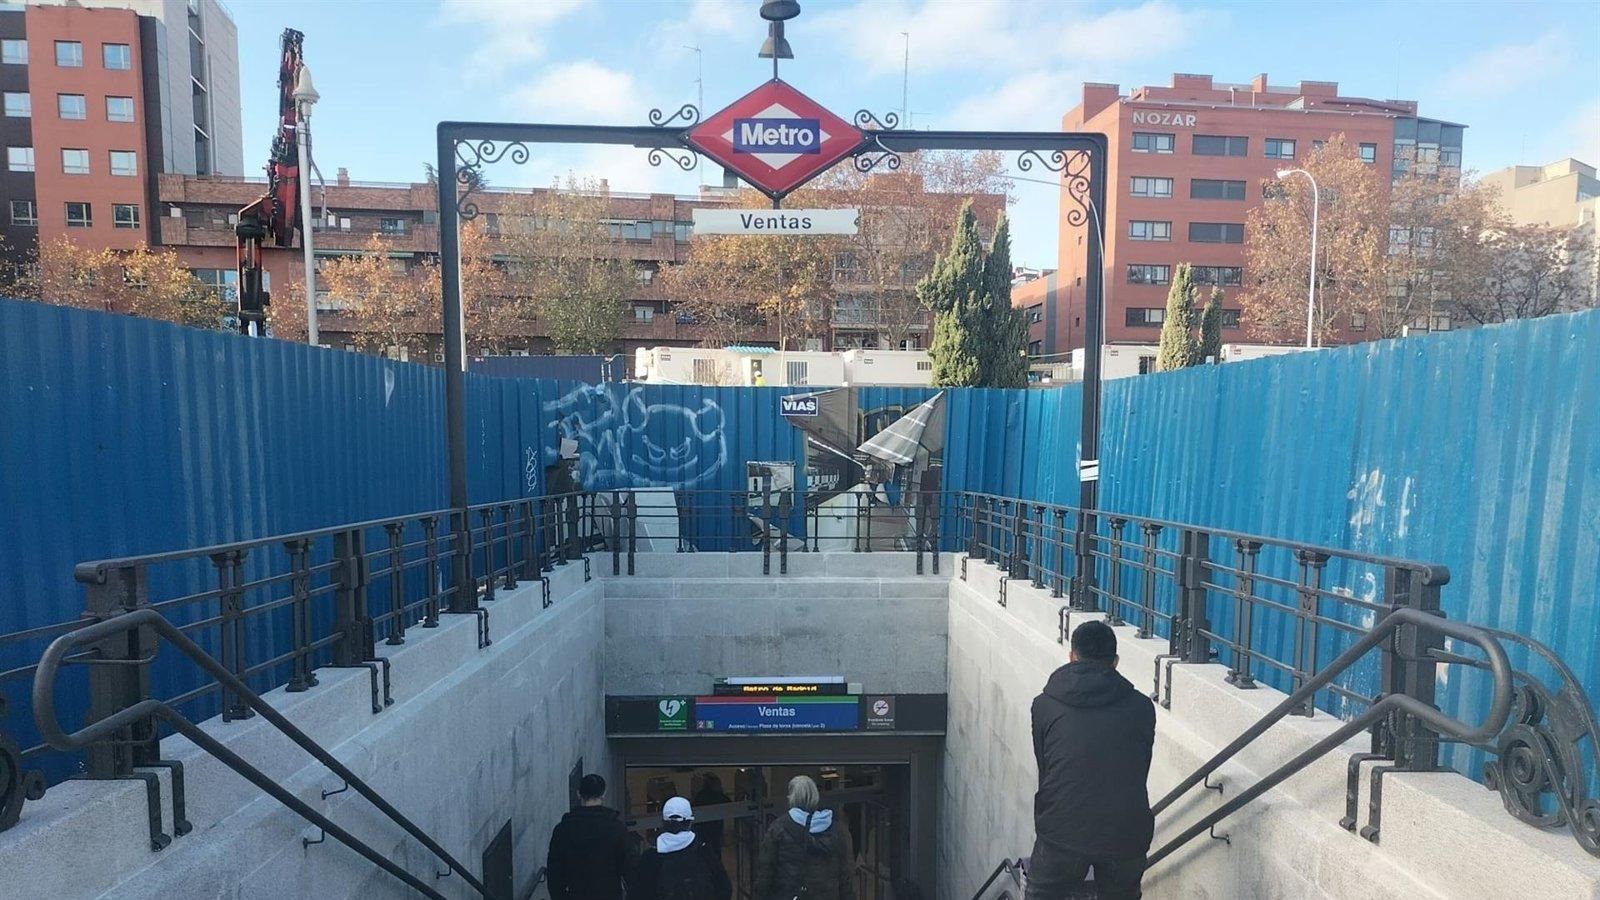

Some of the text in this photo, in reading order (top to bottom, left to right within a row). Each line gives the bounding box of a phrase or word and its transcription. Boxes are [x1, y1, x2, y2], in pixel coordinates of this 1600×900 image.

[1133, 111, 1196, 127] NOZAR
[741, 123, 814, 146] Metro
[740, 213, 812, 229] Ventas
[783, 401, 816, 411] VIAS
[758, 706, 796, 717] Ventas
